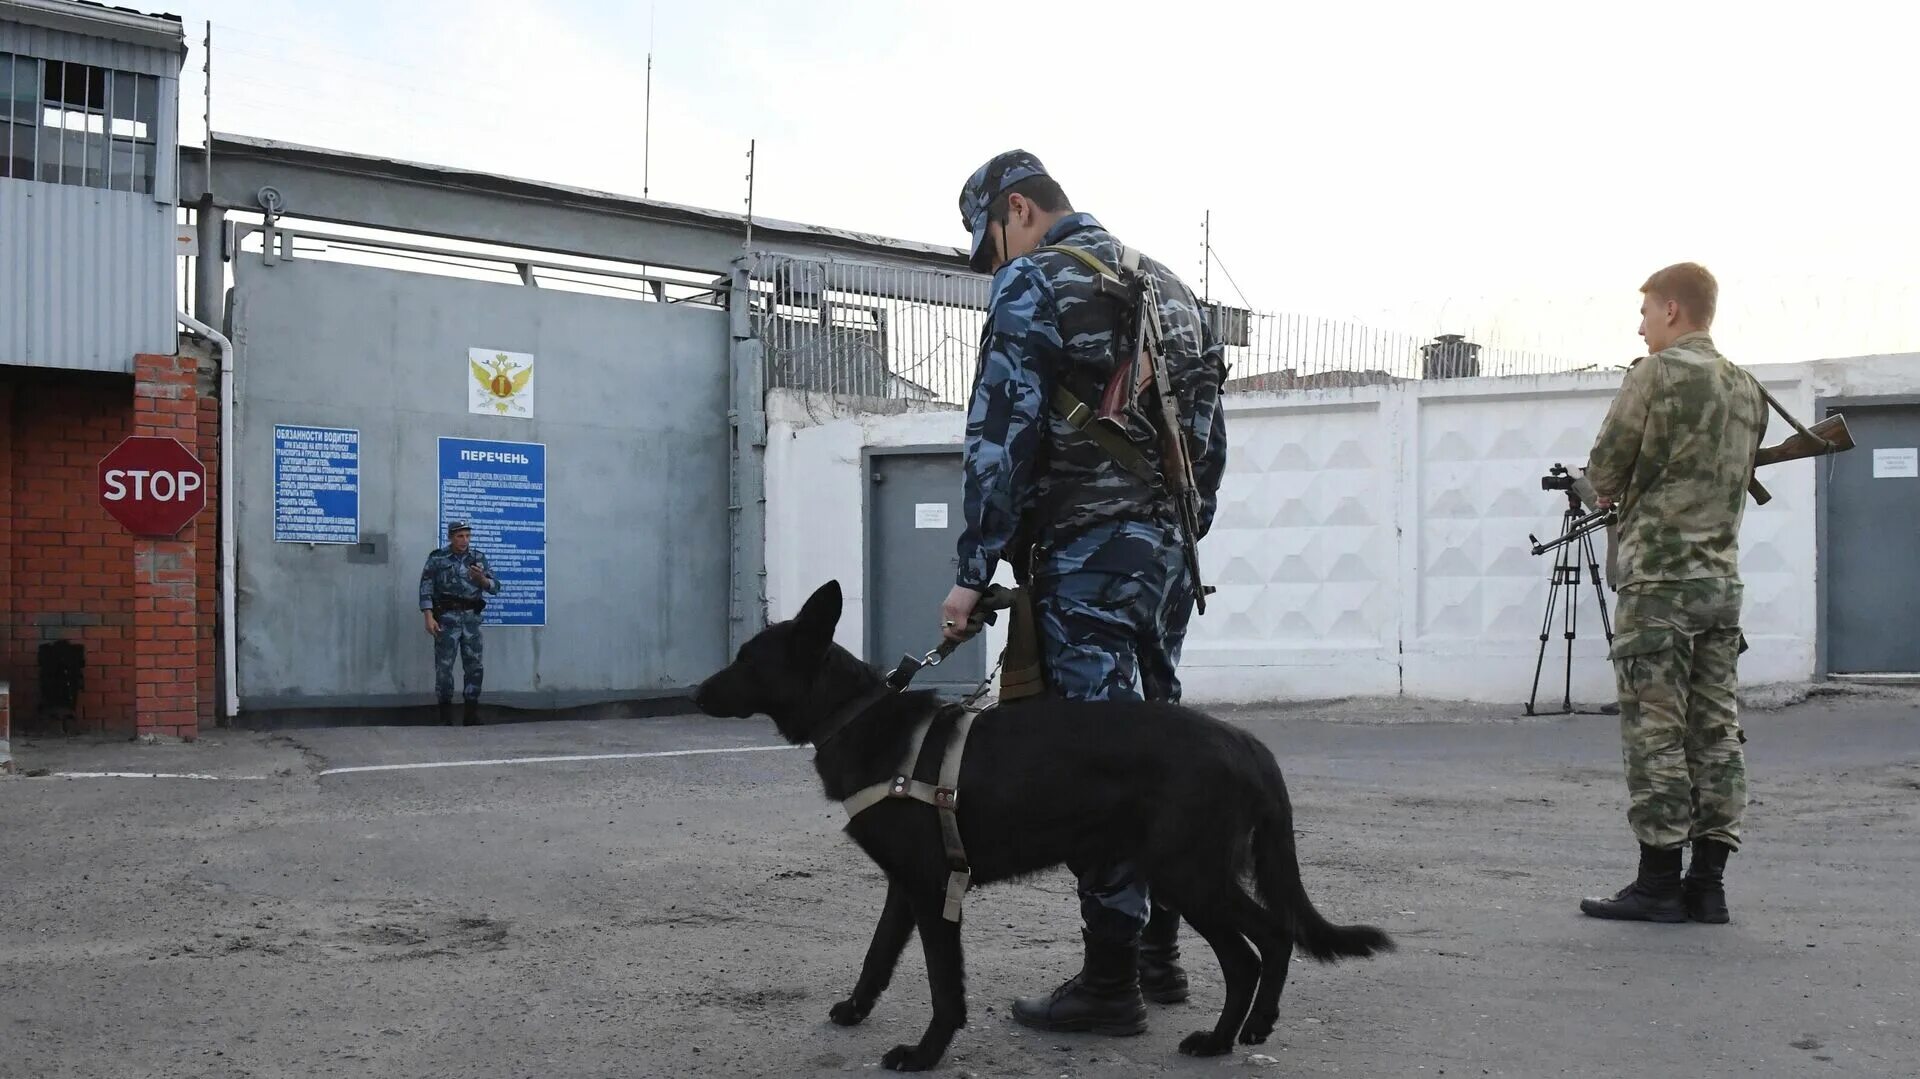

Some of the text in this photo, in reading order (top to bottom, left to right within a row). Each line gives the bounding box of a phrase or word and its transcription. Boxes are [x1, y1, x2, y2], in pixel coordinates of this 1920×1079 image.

[277, 429, 357, 444] ОБЯЗАННОСТИ ВОДИТЕЛЯ
[461, 450, 528, 464] ПЕРЕЧЕНЬ
[104, 470, 200, 501] STOP
